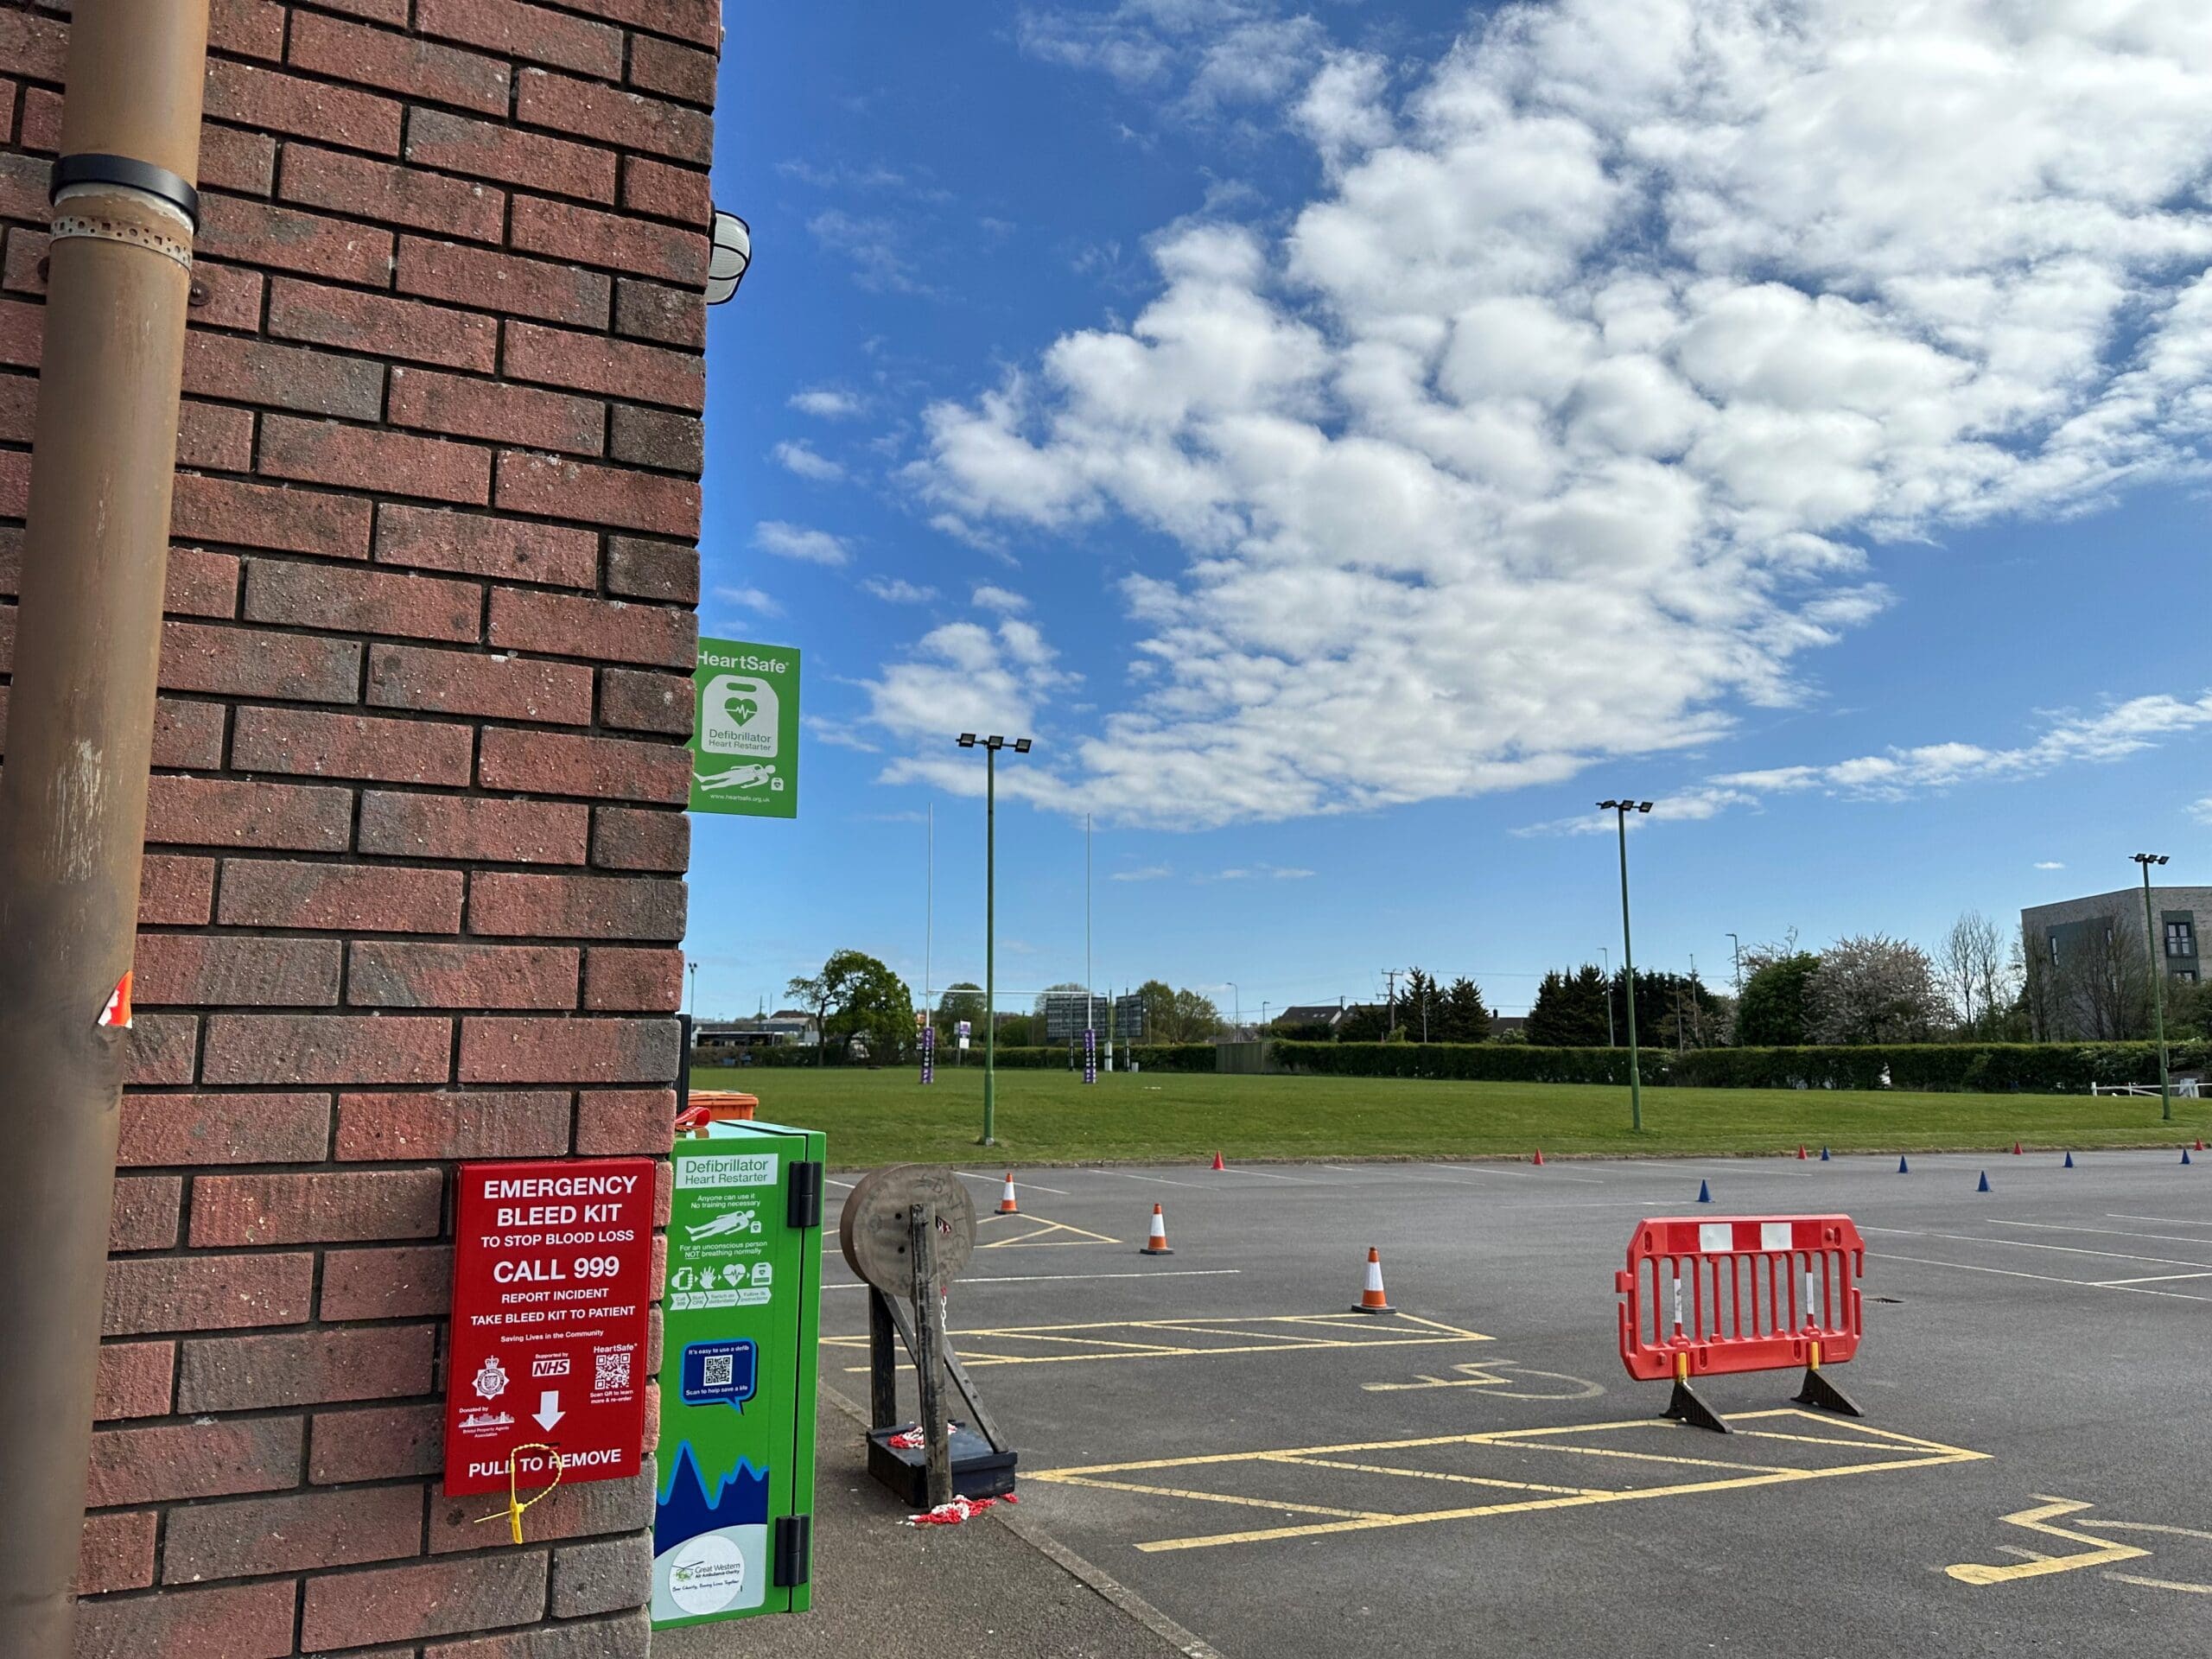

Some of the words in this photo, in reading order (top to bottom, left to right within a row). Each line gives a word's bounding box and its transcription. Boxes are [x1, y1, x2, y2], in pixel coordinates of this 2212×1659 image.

[709, 728, 772, 743] Defibrillator
[709, 739, 733, 748] Heart
[734, 741, 771, 751] Restarter
[710, 794, 770, 804] www.heartsafe.org.uk
[686, 1159, 769, 1173] Defibrillator
[685, 1174, 715, 1185] Heart
[718, 1173, 768, 1184] Restarter
[484, 1175, 638, 1199] EMERGENCY
[702, 1200, 726, 1209] training
[497, 1205, 577, 1227] BLEED
[584, 1204, 622, 1223] KIT
[481, 1236, 500, 1248] TO
[504, 1234, 542, 1247] STOP
[545, 1231, 594, 1245] BLOOD
[598, 1230, 634, 1243] LOSS
[702, 1242, 744, 1250] unconscious
[493, 1258, 566, 1283] CALL
[574, 1256, 620, 1279] 999
[501, 1291, 550, 1304] REPORT
[553, 1287, 609, 1300] INCIDENT
[471, 1314, 502, 1325] TAKE
[505, 1312, 544, 1324] BLEED
[548, 1309, 568, 1321] KIT
[569, 1308, 586, 1319] TO
[588, 1306, 636, 1319] PATIENT
[500, 1334, 524, 1343] Saving
[525, 1332, 543, 1341] Lives
[565, 1329, 604, 1338] Community
[534, 1360, 569, 1376] NHS
[468, 1459, 515, 1478] PULL
[520, 1457, 543, 1472] TO
[549, 1448, 622, 1471] REMOVE
[714, 1563, 741, 1572] Western
